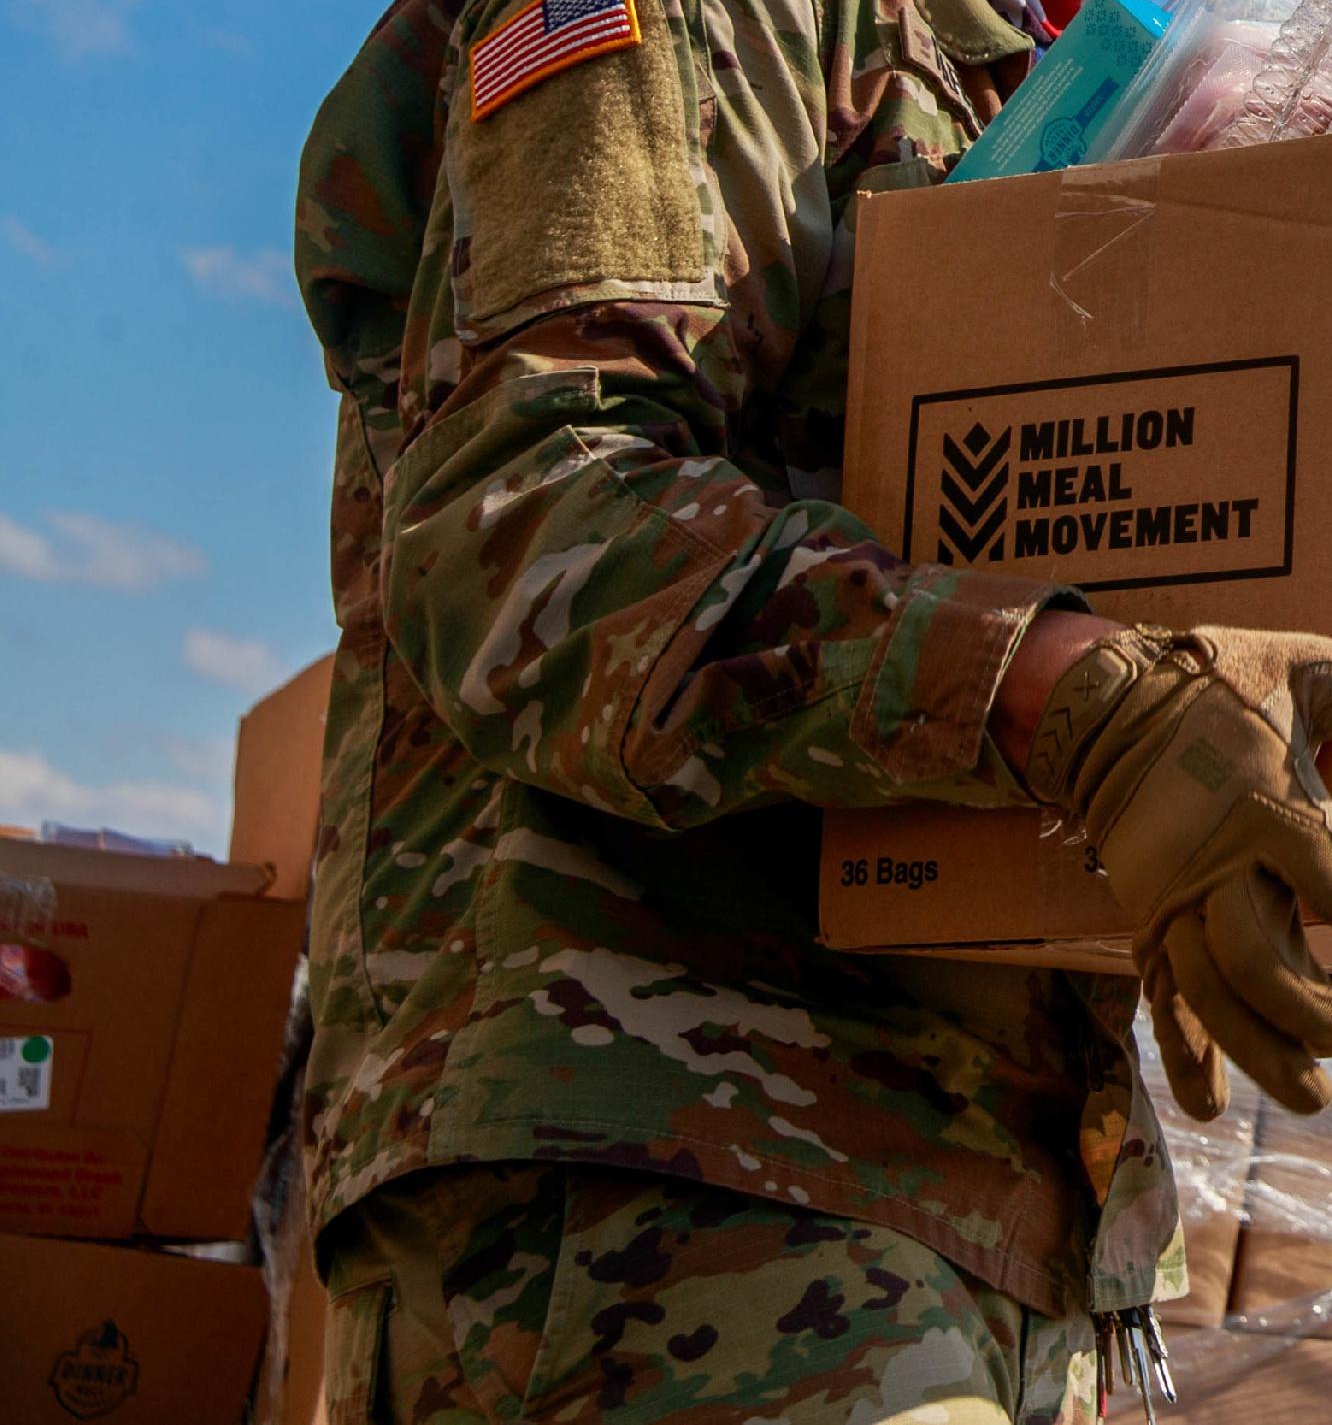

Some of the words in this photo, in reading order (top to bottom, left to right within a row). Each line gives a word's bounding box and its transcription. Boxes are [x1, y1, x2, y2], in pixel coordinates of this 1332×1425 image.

[1019, 406, 1195, 462] MILLION
[1017, 463, 1132, 509] MEAL
[1014, 498, 1259, 558] MOVEMENT
[840, 858, 868, 886] 36
[876, 857, 938, 890] Bags
